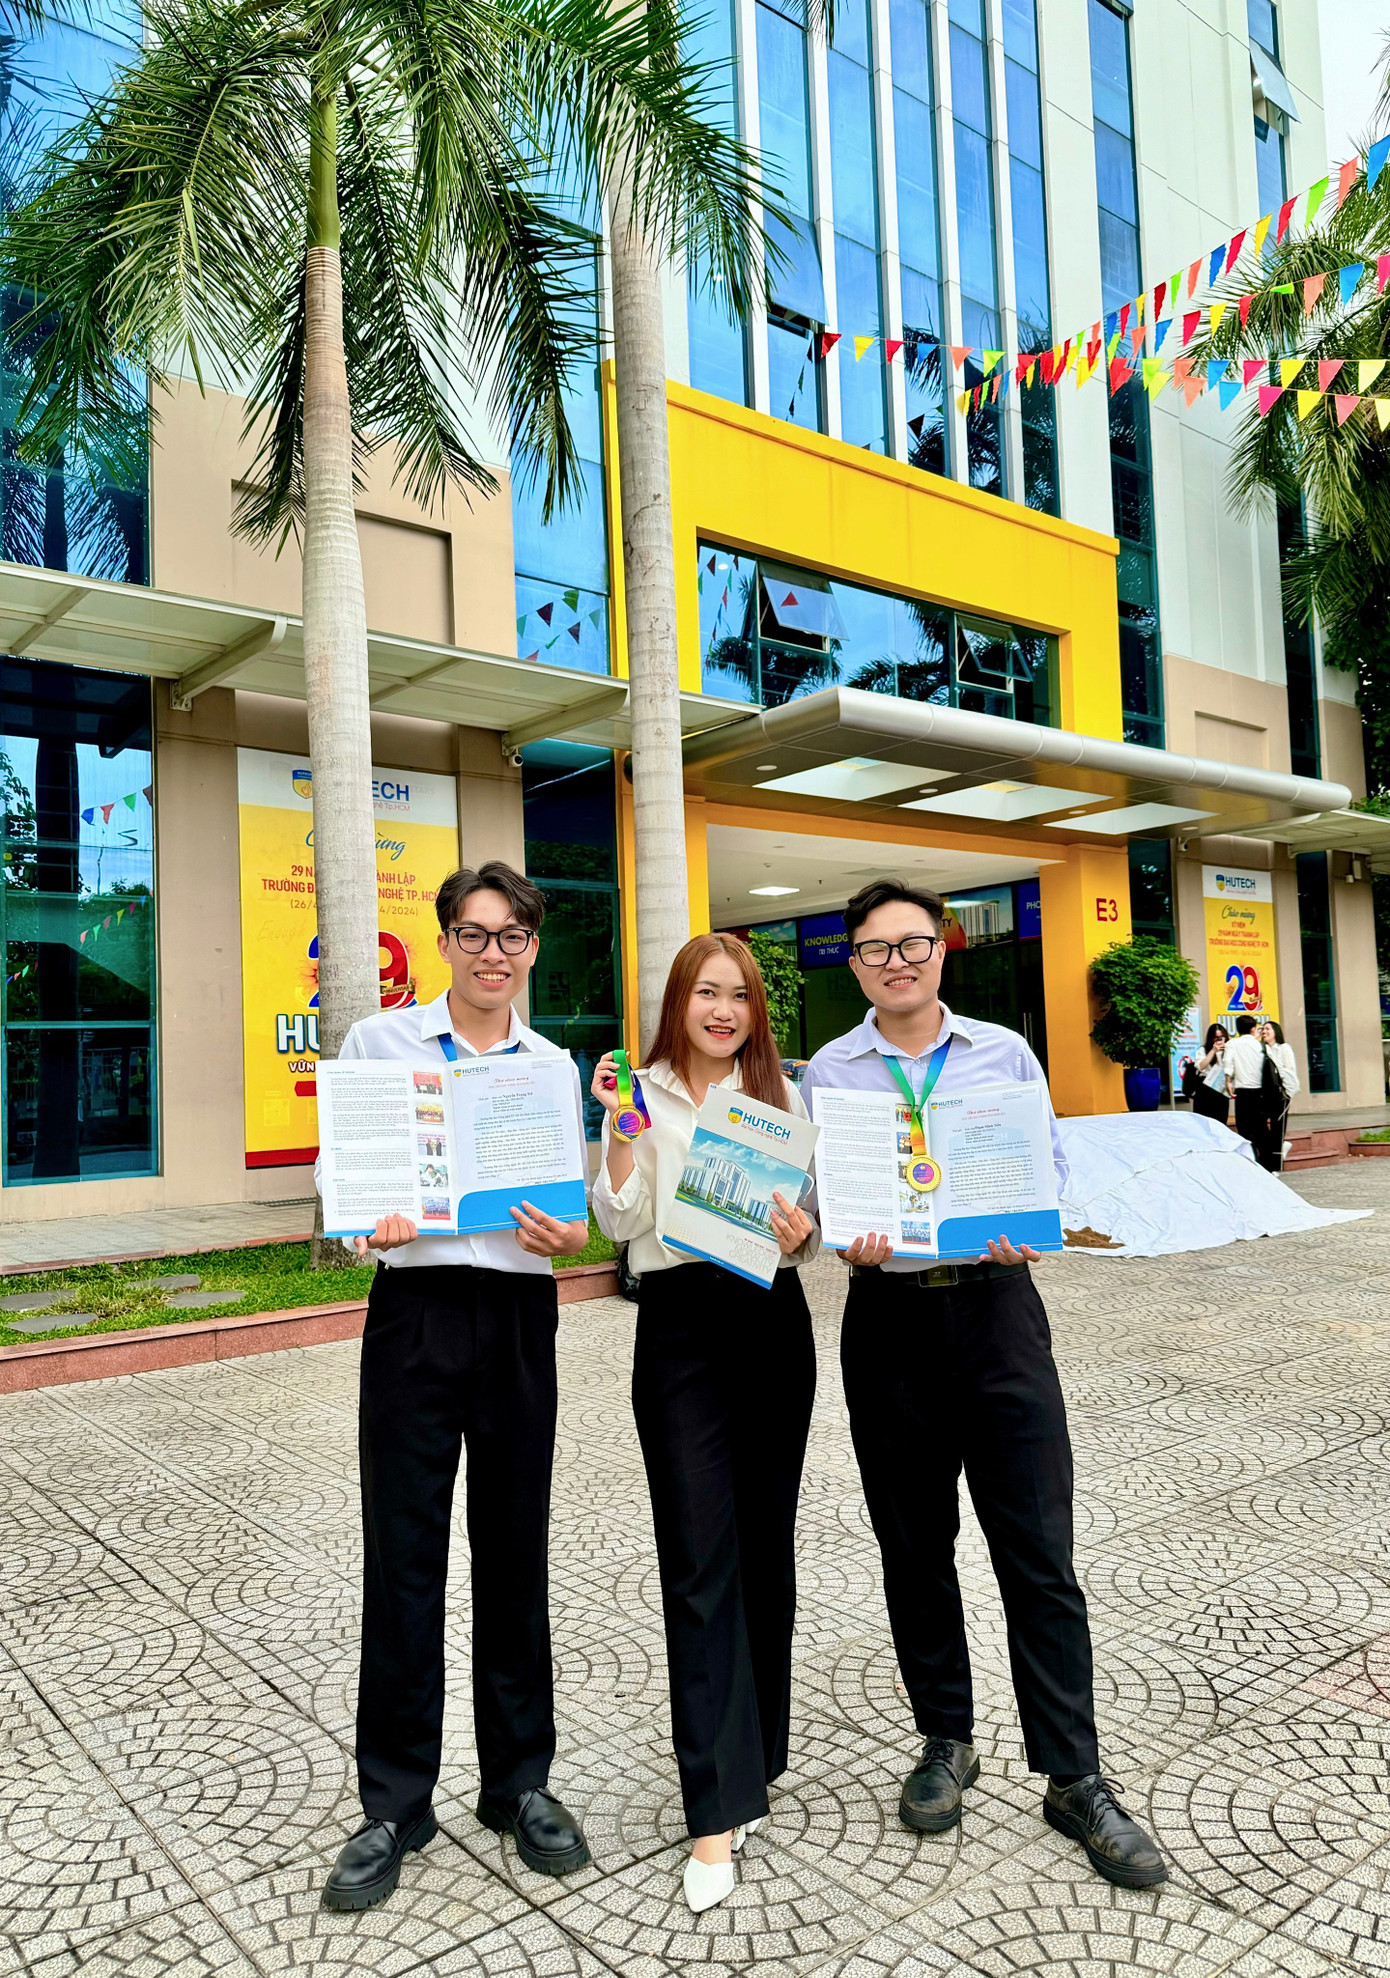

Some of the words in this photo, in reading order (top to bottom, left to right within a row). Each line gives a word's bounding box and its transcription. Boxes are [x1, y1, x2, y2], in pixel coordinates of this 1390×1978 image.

[372, 780, 410, 801] ECH
[375, 832, 406, 861] ừng
[291, 865, 304, 876] 29
[377, 868, 396, 884] ÀNH
[262, 878, 306, 893] TRƯỜNG
[1225, 876, 1257, 889] HUTECH
[1096, 897, 1119, 922] E3
[804, 932, 849, 947] KNOWLEDG
[1225, 964, 1260, 1012] 29
[288, 1058, 316, 1073] VỮN
[462, 1066, 490, 1074] HUTECH
[743, 1112, 791, 1141] HUTECH
